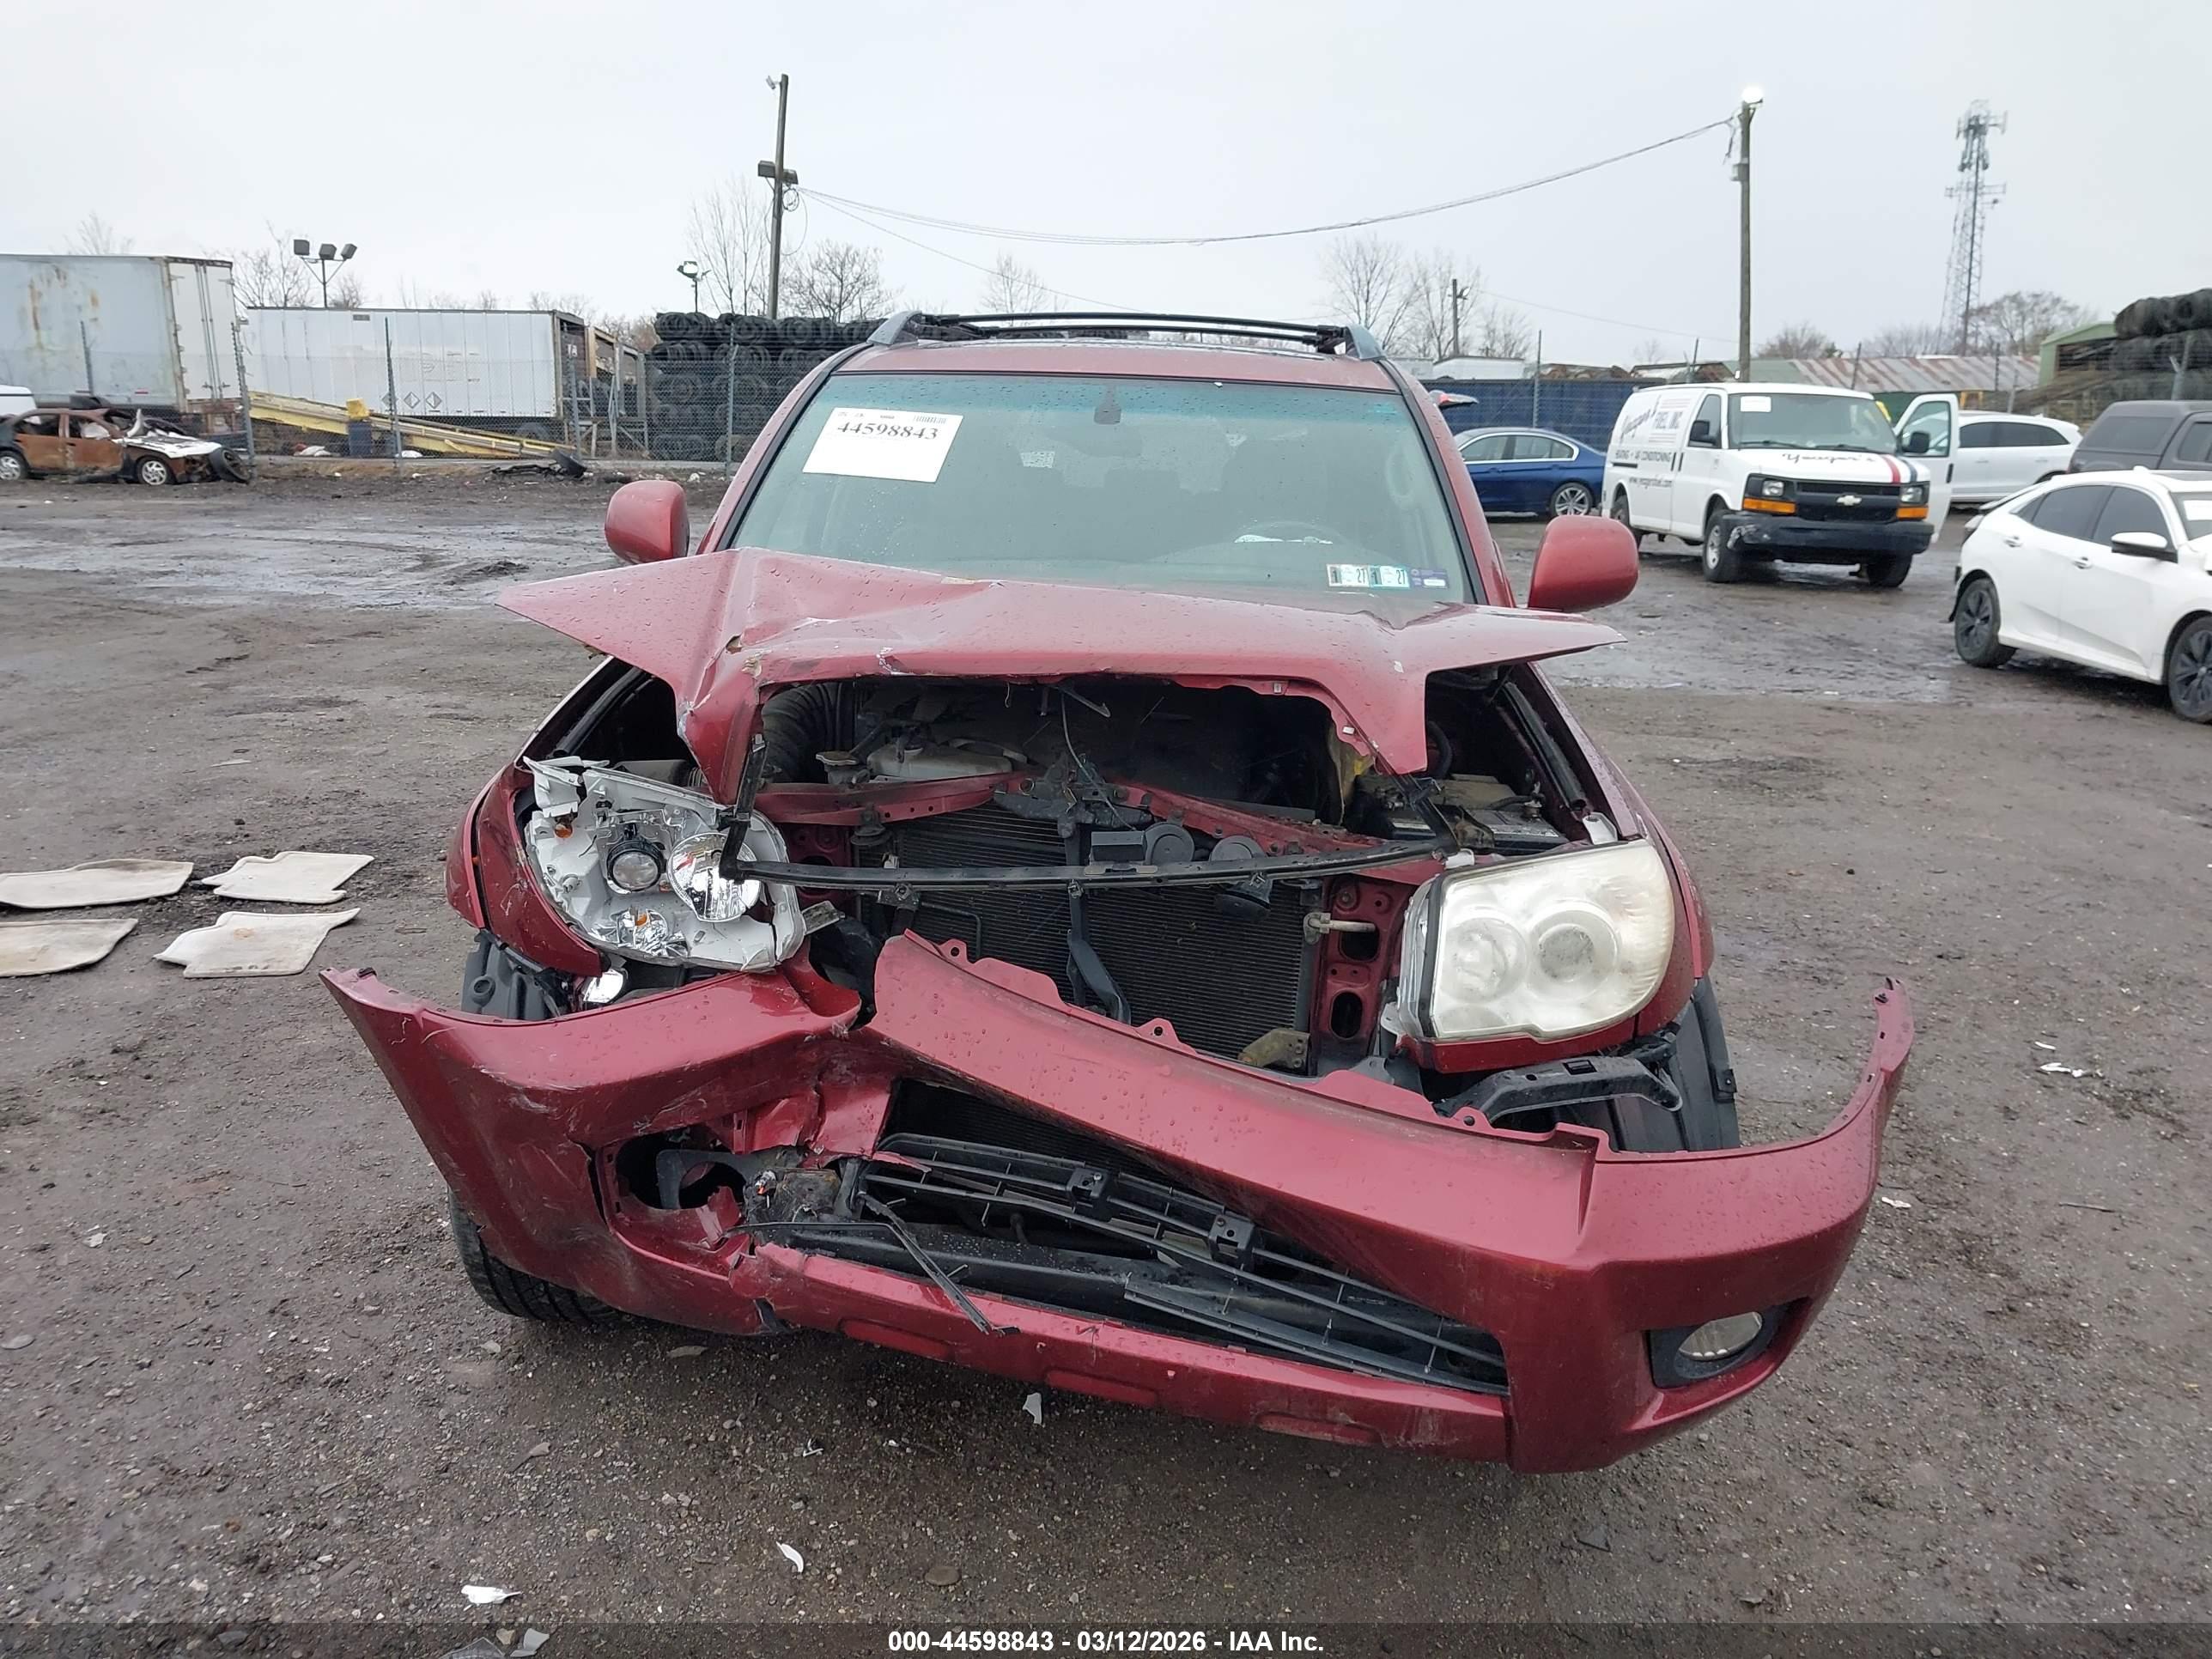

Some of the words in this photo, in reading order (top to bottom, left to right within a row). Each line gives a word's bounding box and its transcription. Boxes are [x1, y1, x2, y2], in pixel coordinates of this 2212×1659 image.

[837, 422, 939, 440] 44598843
[1357, 568, 1366, 584] 27
[1396, 569, 1407, 585] 27
